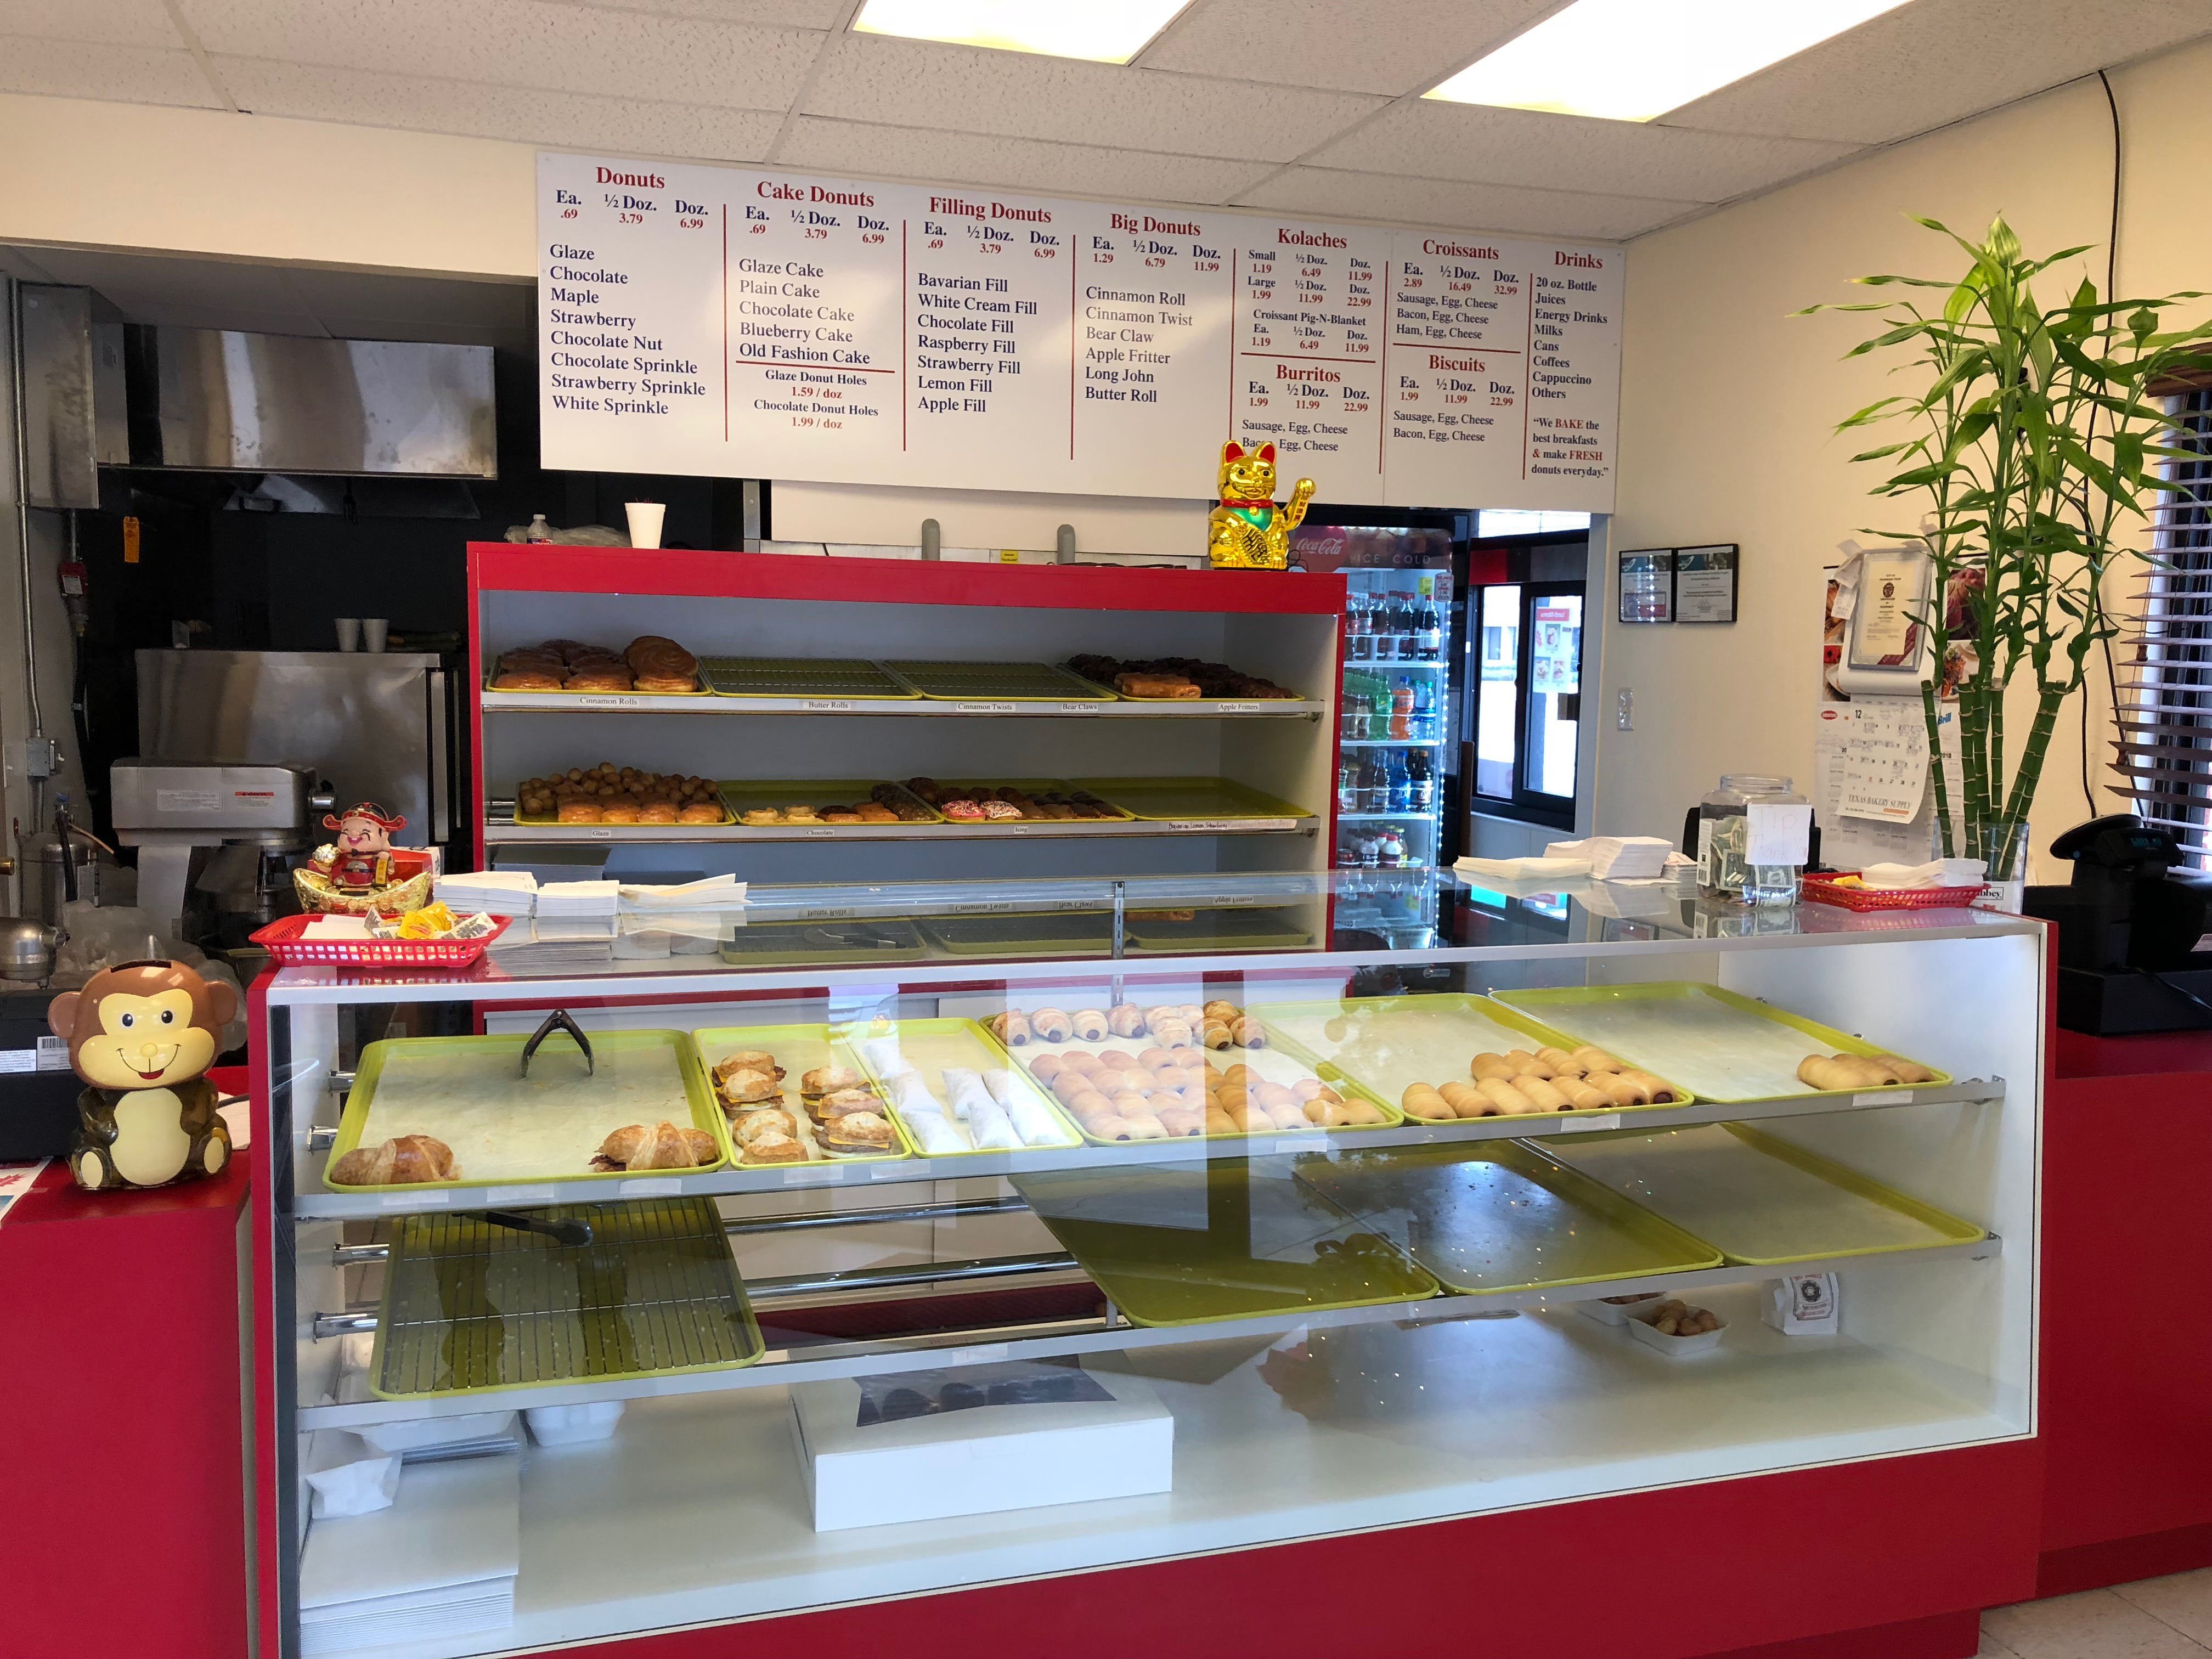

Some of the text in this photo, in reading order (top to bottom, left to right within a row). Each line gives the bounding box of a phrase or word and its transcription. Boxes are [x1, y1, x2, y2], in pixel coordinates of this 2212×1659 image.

[596, 167, 664, 189] Donuts
[556, 190, 582, 205] Ea.
[623, 195, 657, 211] Doz.
[675, 200, 708, 215] Doz.
[757, 182, 874, 207] Cake Donuts
[561, 208, 703, 229] .69 3.79 6.99
[930, 197, 1051, 223] Filling Donuts
[1110, 213, 1200, 236] Big Donuts
[1278, 229, 1346, 249] Kolaches
[550, 244, 594, 260] Glaze
[1423, 240, 1498, 259] Croissants
[740, 258, 823, 278] Glaze Cake
[1094, 253, 1219, 272] 1.29 6.79 11.99
[1555, 251, 1602, 269] Drinks
[550, 266, 628, 284] Chocolate
[1253, 263, 1372, 281] 1.19 6.49 11.99
[740, 280, 820, 298] Plain Cake
[918, 273, 1008, 292] Bavarian Fill
[1404, 278, 1517, 295] 2.89 16.49 32.99
[1536, 277, 1548, 287] 20
[1568, 279, 1597, 292] Bottle
[551, 287, 599, 306] Maple
[918, 294, 1037, 314] White Cream Fill
[1086, 286, 1185, 306] Cinnamon Roll
[1397, 292, 1498, 309] Sausage, Egg, Cheese
[1535, 292, 1565, 304] Juices
[740, 301, 854, 321] Chocolate Cake
[1086, 307, 1192, 326] Cinnamon Twist
[1254, 309, 1365, 326] Croissant Pig-N-Blanket
[1535, 308, 1607, 323] Energy Drinks
[551, 309, 636, 331] Strawberry
[918, 314, 1014, 333] Chocolate Fill
[740, 322, 853, 342] Blueberry Cake
[1086, 326, 1154, 342] Bear Claw
[1534, 324, 1562, 336] Milks
[551, 331, 663, 351] Chocolate Nut
[918, 335, 1015, 354] Raspberry Fill
[1534, 340, 1559, 351] Cans
[740, 343, 870, 364] Old Fashion Cake
[1086, 347, 1170, 364] Apple Fritter
[1533, 356, 1570, 368] Coffees
[551, 352, 697, 375] Chocolate Sprinkle
[918, 355, 1020, 375] Strawberry Fill
[1429, 355, 1485, 372] Biscuits
[765, 370, 867, 385] Glaze Donut Holes
[1085, 366, 1154, 383] Long John
[1276, 364, 1340, 382] Burritos
[1533, 371, 1592, 385] Cappuccino
[552, 374, 706, 396] Strawberry Sprinkle
[918, 376, 992, 392] Lemon Fill
[1532, 387, 1566, 398] Others
[792, 387, 813, 397] 1.59
[823, 388, 842, 399] doz
[1085, 386, 1156, 402] Butter Roll
[552, 396, 668, 415] White Sprinkle
[754, 399, 878, 416] Chocolate Donut Holes
[918, 396, 986, 413] Apple Fill
[793, 417, 813, 427] 1.99
[823, 419, 842, 428] doz
[1555, 419, 1583, 428] BAKE
[1586, 421, 1599, 430] the
[1279, 439, 1301, 452] Egg,
[1304, 440, 1338, 451] Cheese
[1533, 433, 1597, 445] best breakfasts
[1533, 449, 1602, 461] & make FRESH
[1532, 464, 1561, 474] donuts
[1296, 538, 1344, 555] Coca-Cola
[1358, 554, 1430, 564] ICE COLD
[1855, 709, 1862, 719] 12
[1848, 794, 1911, 809] TEXAS BAKERY SUPPLY
